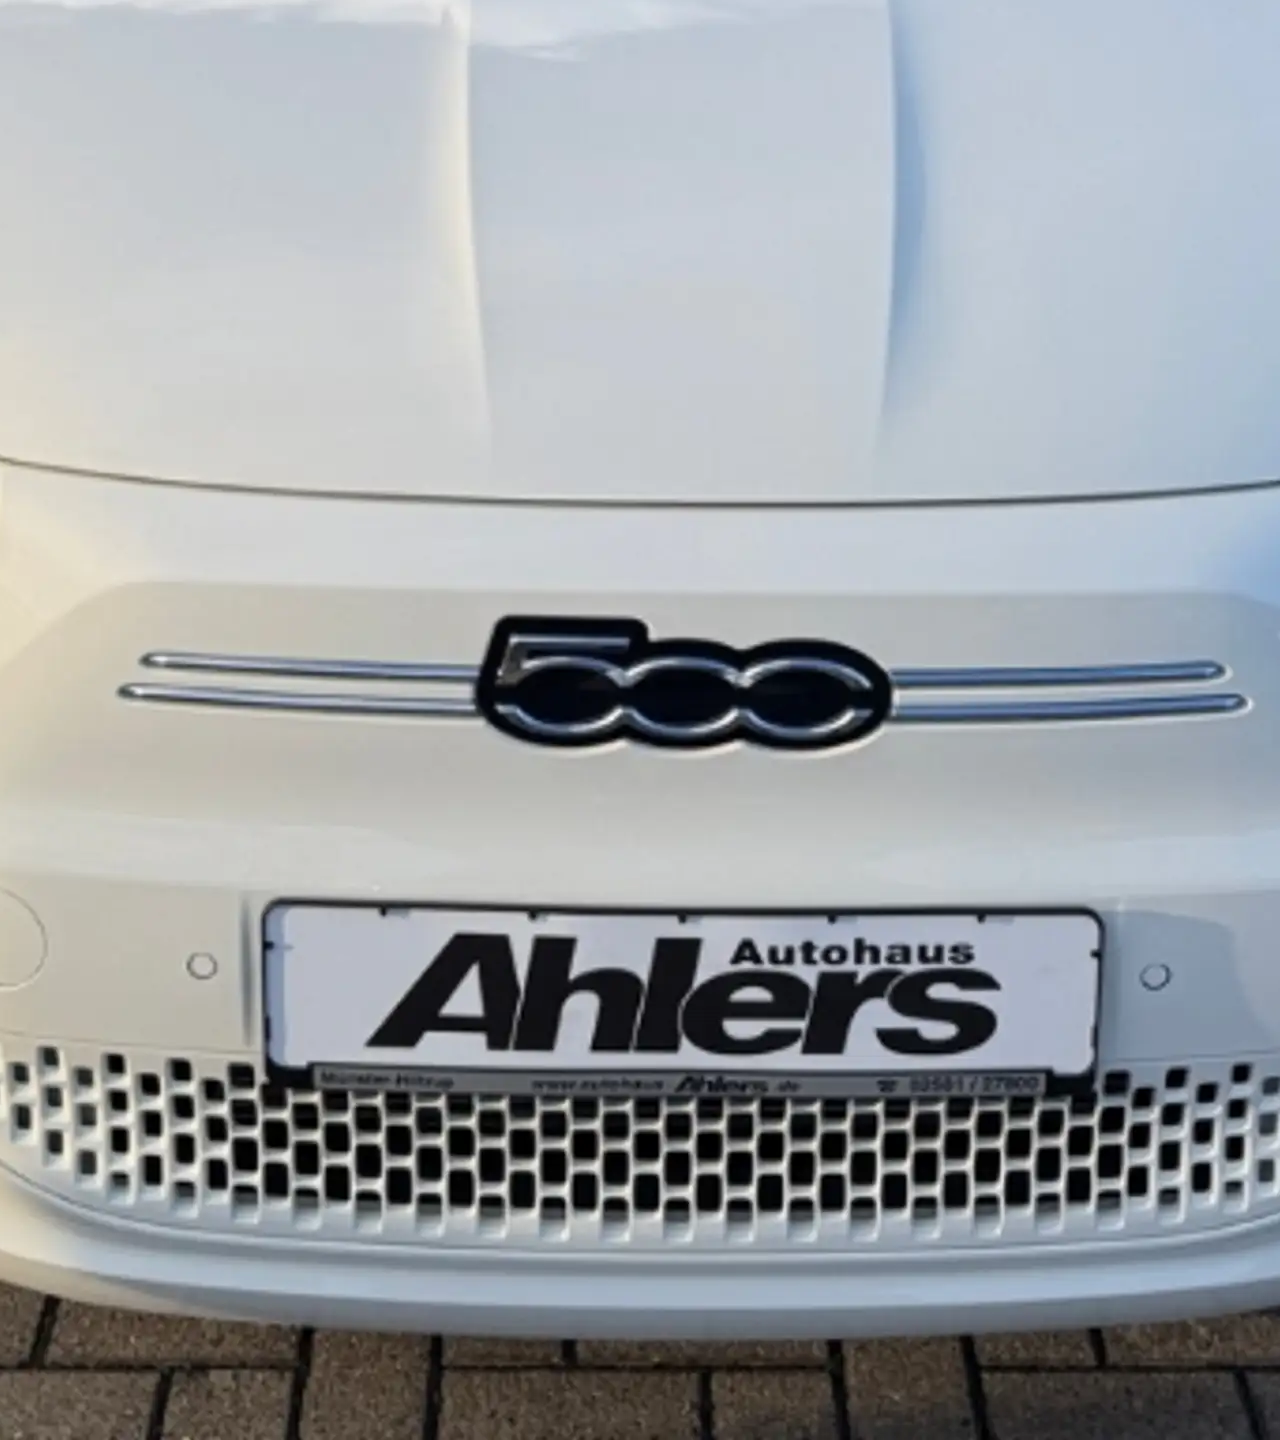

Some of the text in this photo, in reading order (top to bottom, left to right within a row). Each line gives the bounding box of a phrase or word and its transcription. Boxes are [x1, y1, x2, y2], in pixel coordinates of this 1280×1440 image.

[477, 616, 892, 750] 500
[365, 932, 1001, 1056] Ahlers
[729, 938, 975, 965] Autohaus
